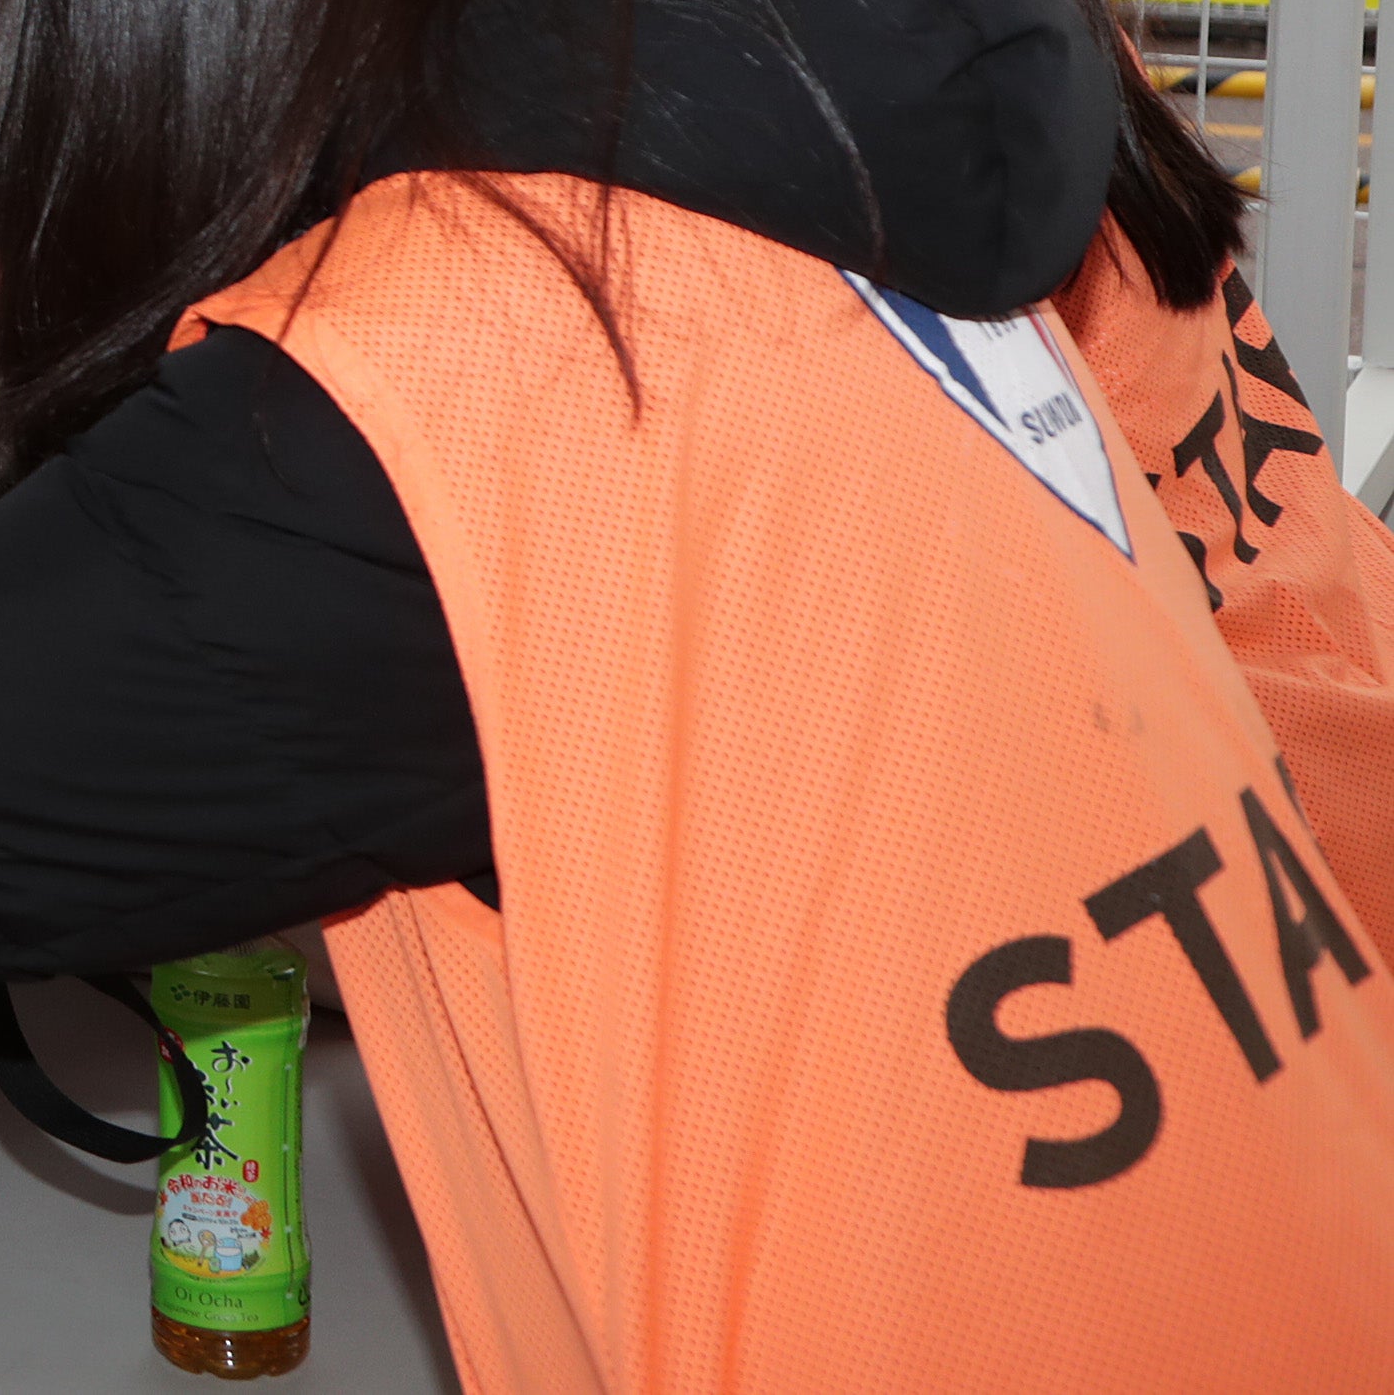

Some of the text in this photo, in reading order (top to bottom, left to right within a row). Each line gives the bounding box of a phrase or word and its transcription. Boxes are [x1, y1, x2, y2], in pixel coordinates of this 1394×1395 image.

[945, 754, 1373, 1189] STA
[175, 1286, 244, 1309] Oi Ocha
[242, 1313, 259, 1323] Tea
